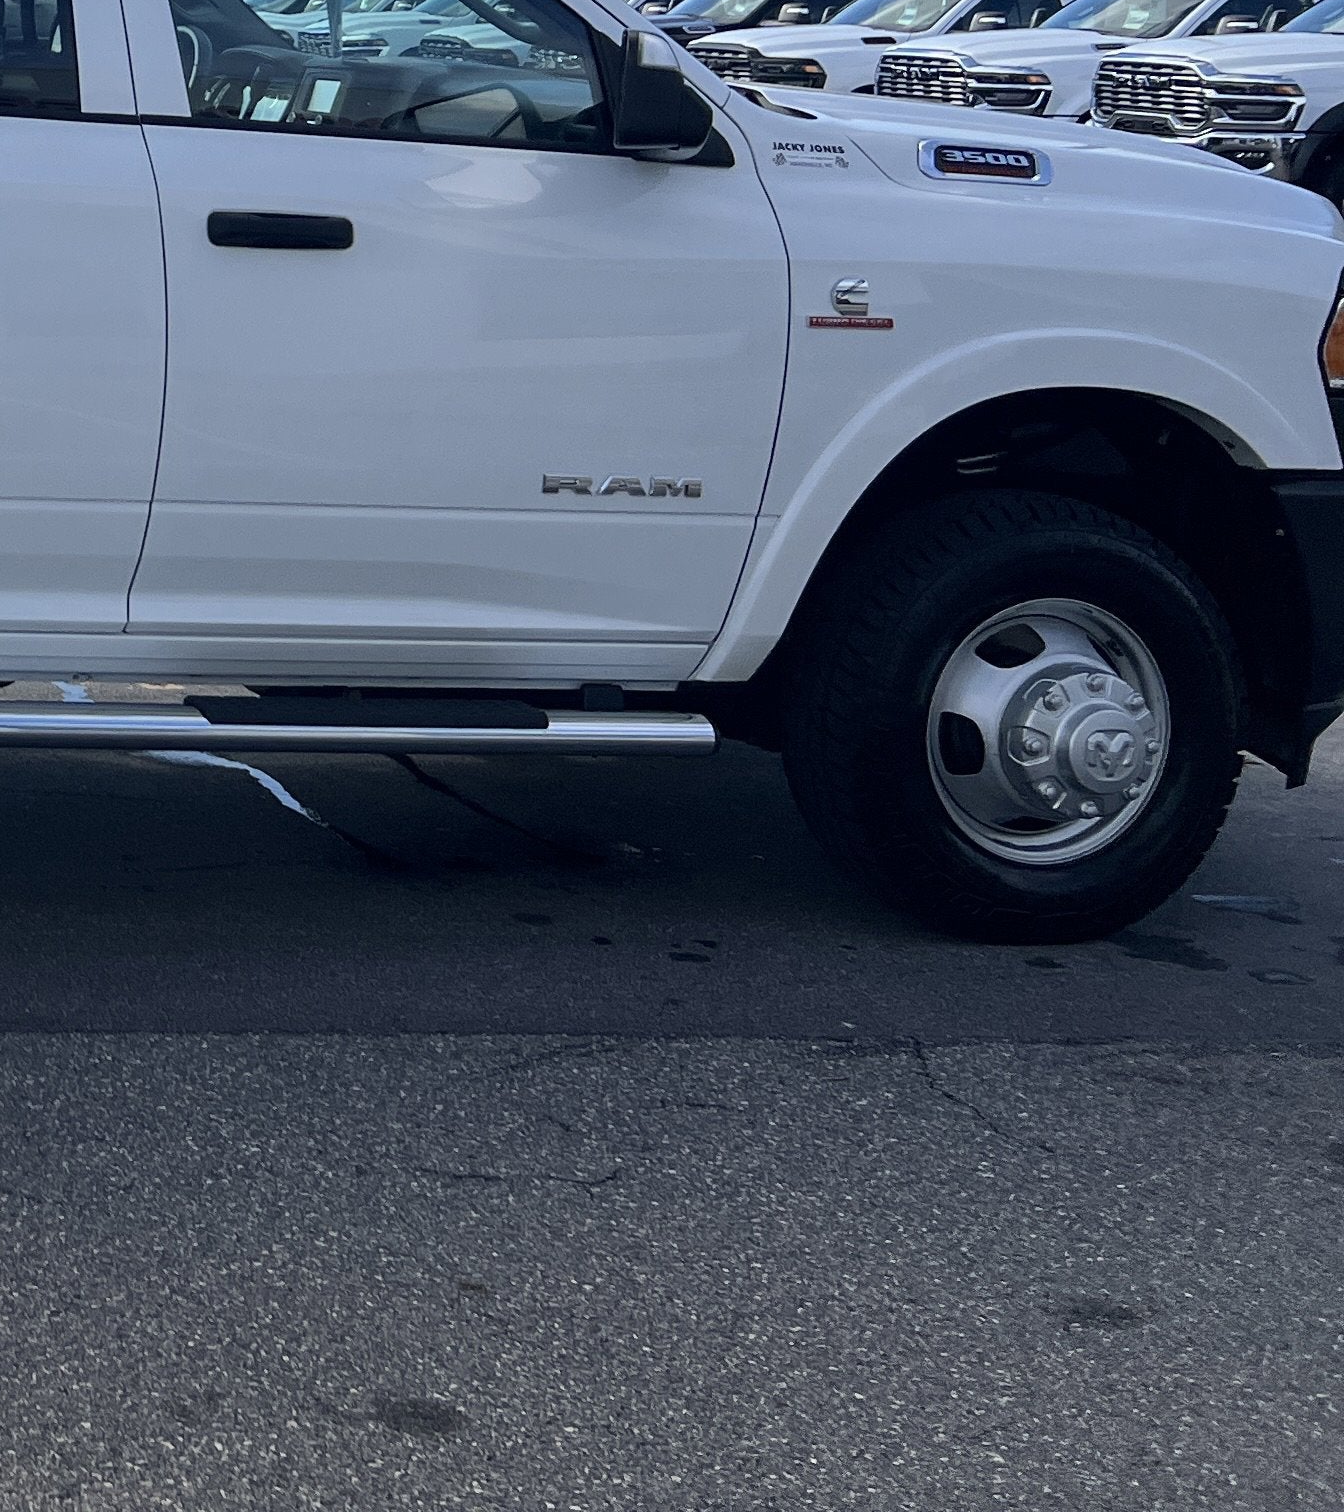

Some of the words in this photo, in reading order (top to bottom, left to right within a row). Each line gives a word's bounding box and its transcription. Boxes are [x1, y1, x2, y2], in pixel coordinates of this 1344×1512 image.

[772, 141, 805, 152] JACKY
[809, 143, 846, 154] JONES
[941, 149, 1030, 167] 3500
[542, 473, 704, 498] RAM
